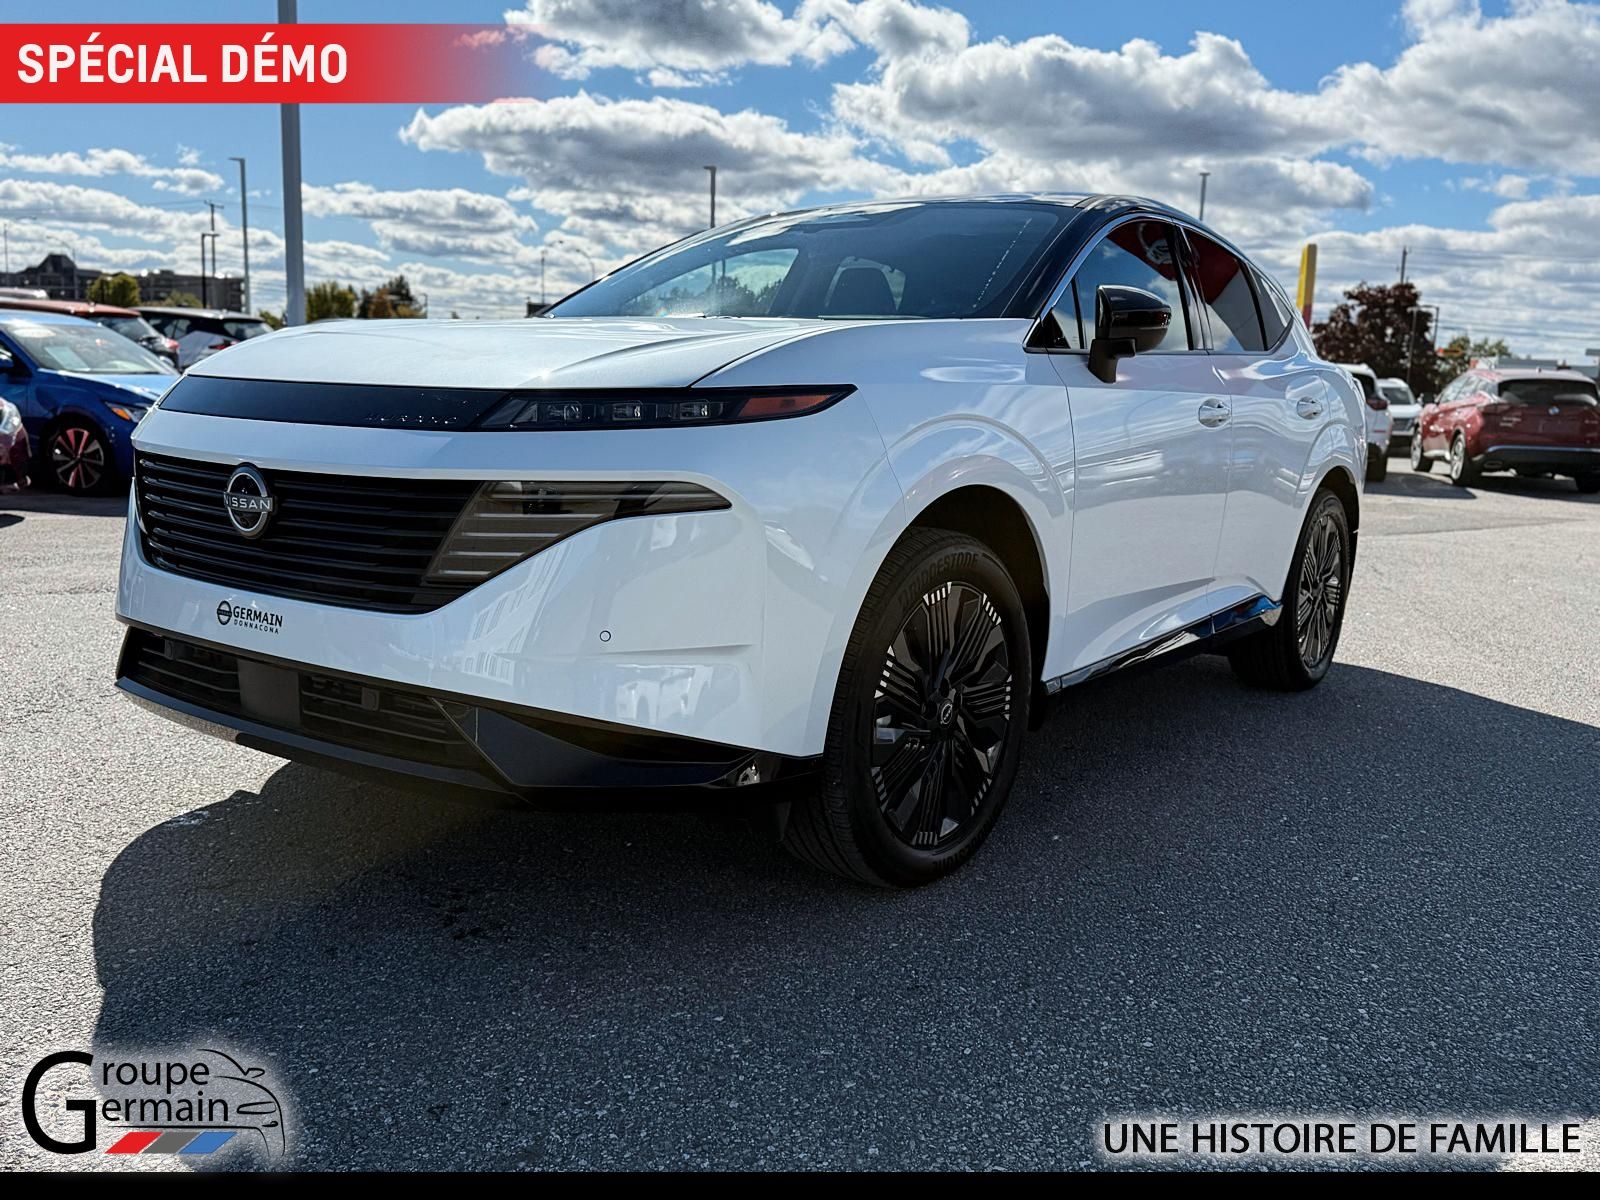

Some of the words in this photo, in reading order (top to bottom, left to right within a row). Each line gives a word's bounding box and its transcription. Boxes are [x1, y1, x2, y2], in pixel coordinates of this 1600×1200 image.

[223, 491, 271, 510] NISSAN
[233, 606, 283, 627] GERMAIN
[234, 619, 279, 634] DONNACONA
